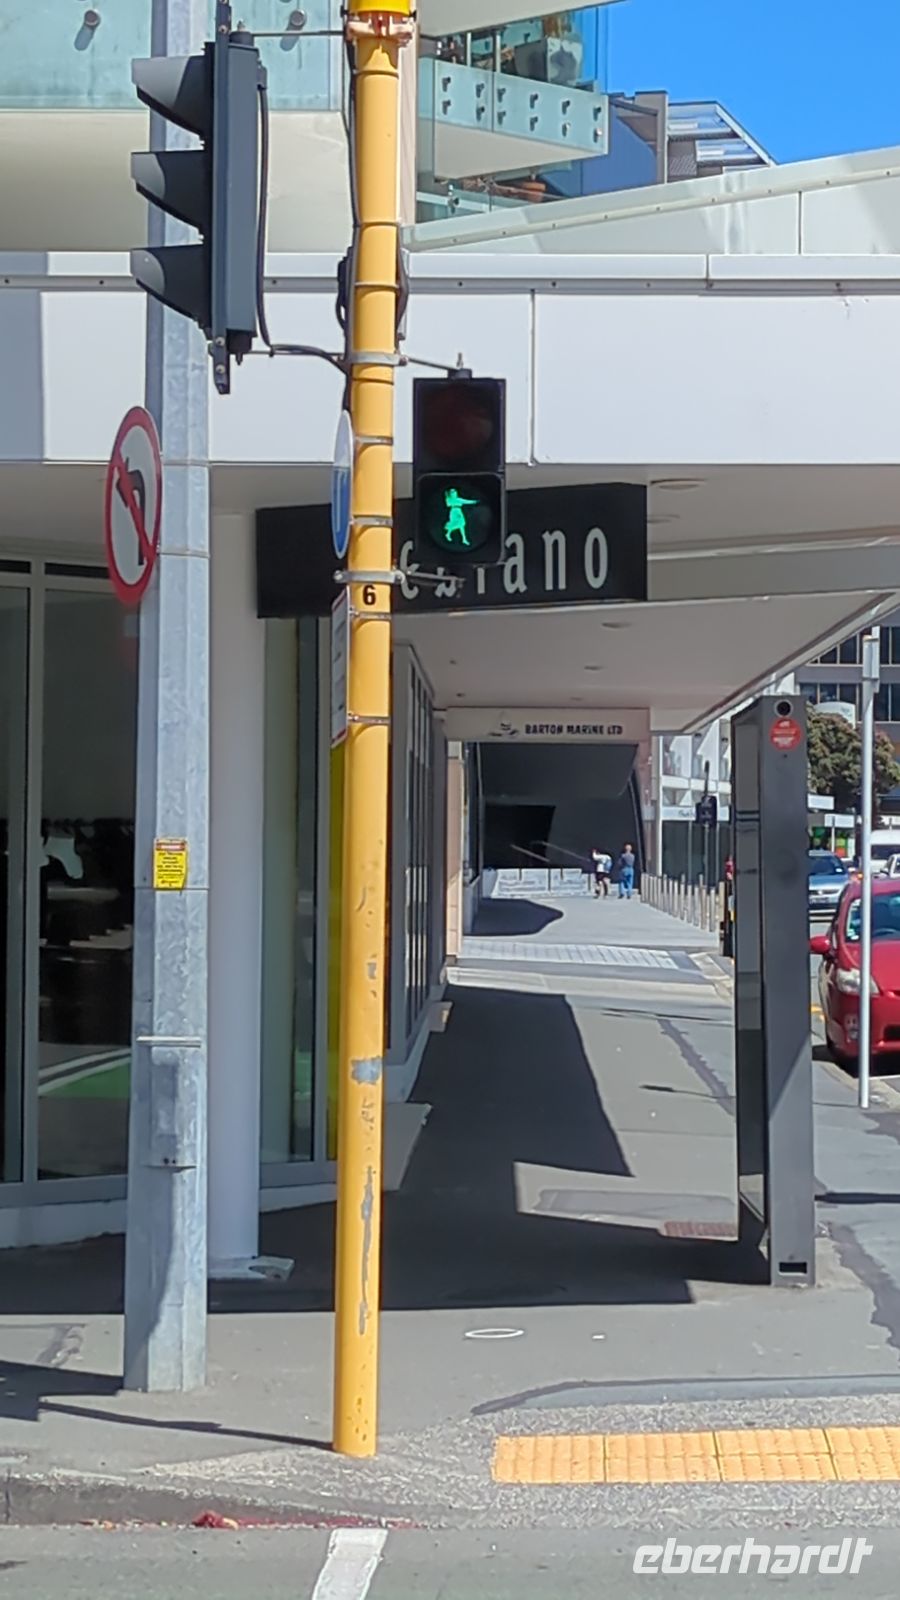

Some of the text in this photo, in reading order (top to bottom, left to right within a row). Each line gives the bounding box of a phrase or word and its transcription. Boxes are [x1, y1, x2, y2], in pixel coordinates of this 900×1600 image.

[363, 585, 376, 605] 6
[525, 724, 623, 735] BARTON MARINE LTD
